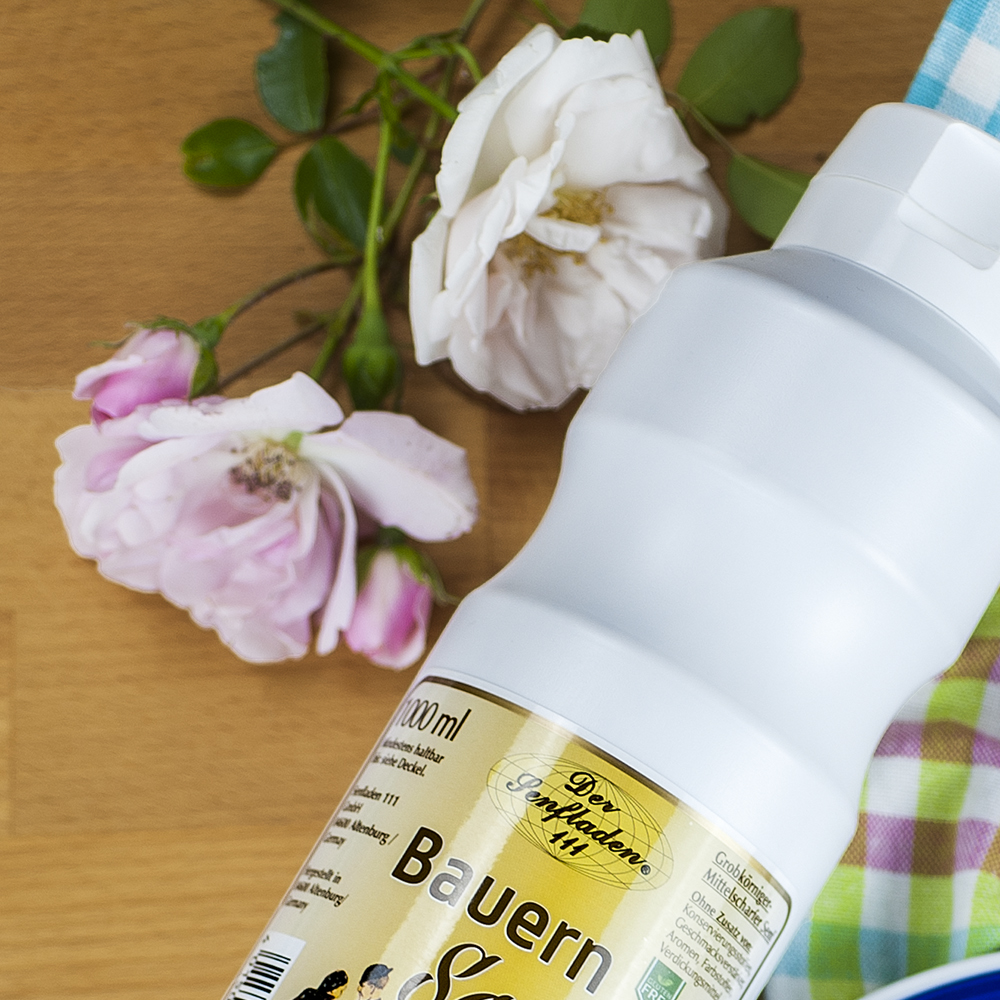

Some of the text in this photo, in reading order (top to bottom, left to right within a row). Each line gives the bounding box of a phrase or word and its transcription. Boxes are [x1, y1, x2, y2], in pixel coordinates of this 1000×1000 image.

[430, 708, 472, 742] ml
[413, 743, 445, 764] haltbar
[382, 793, 400, 807] 111
[564, 772, 621, 812] Der
[549, 831, 590, 856] 111
[391, 825, 613, 995] Bauern
[703, 867, 763, 928] Mittelscharfer
[691, 890, 717, 917] Ohne
[715, 911, 742, 940] Zusatz
[666, 930, 701, 965] Aromen,
[646, 976, 673, 999] GLUTEN
